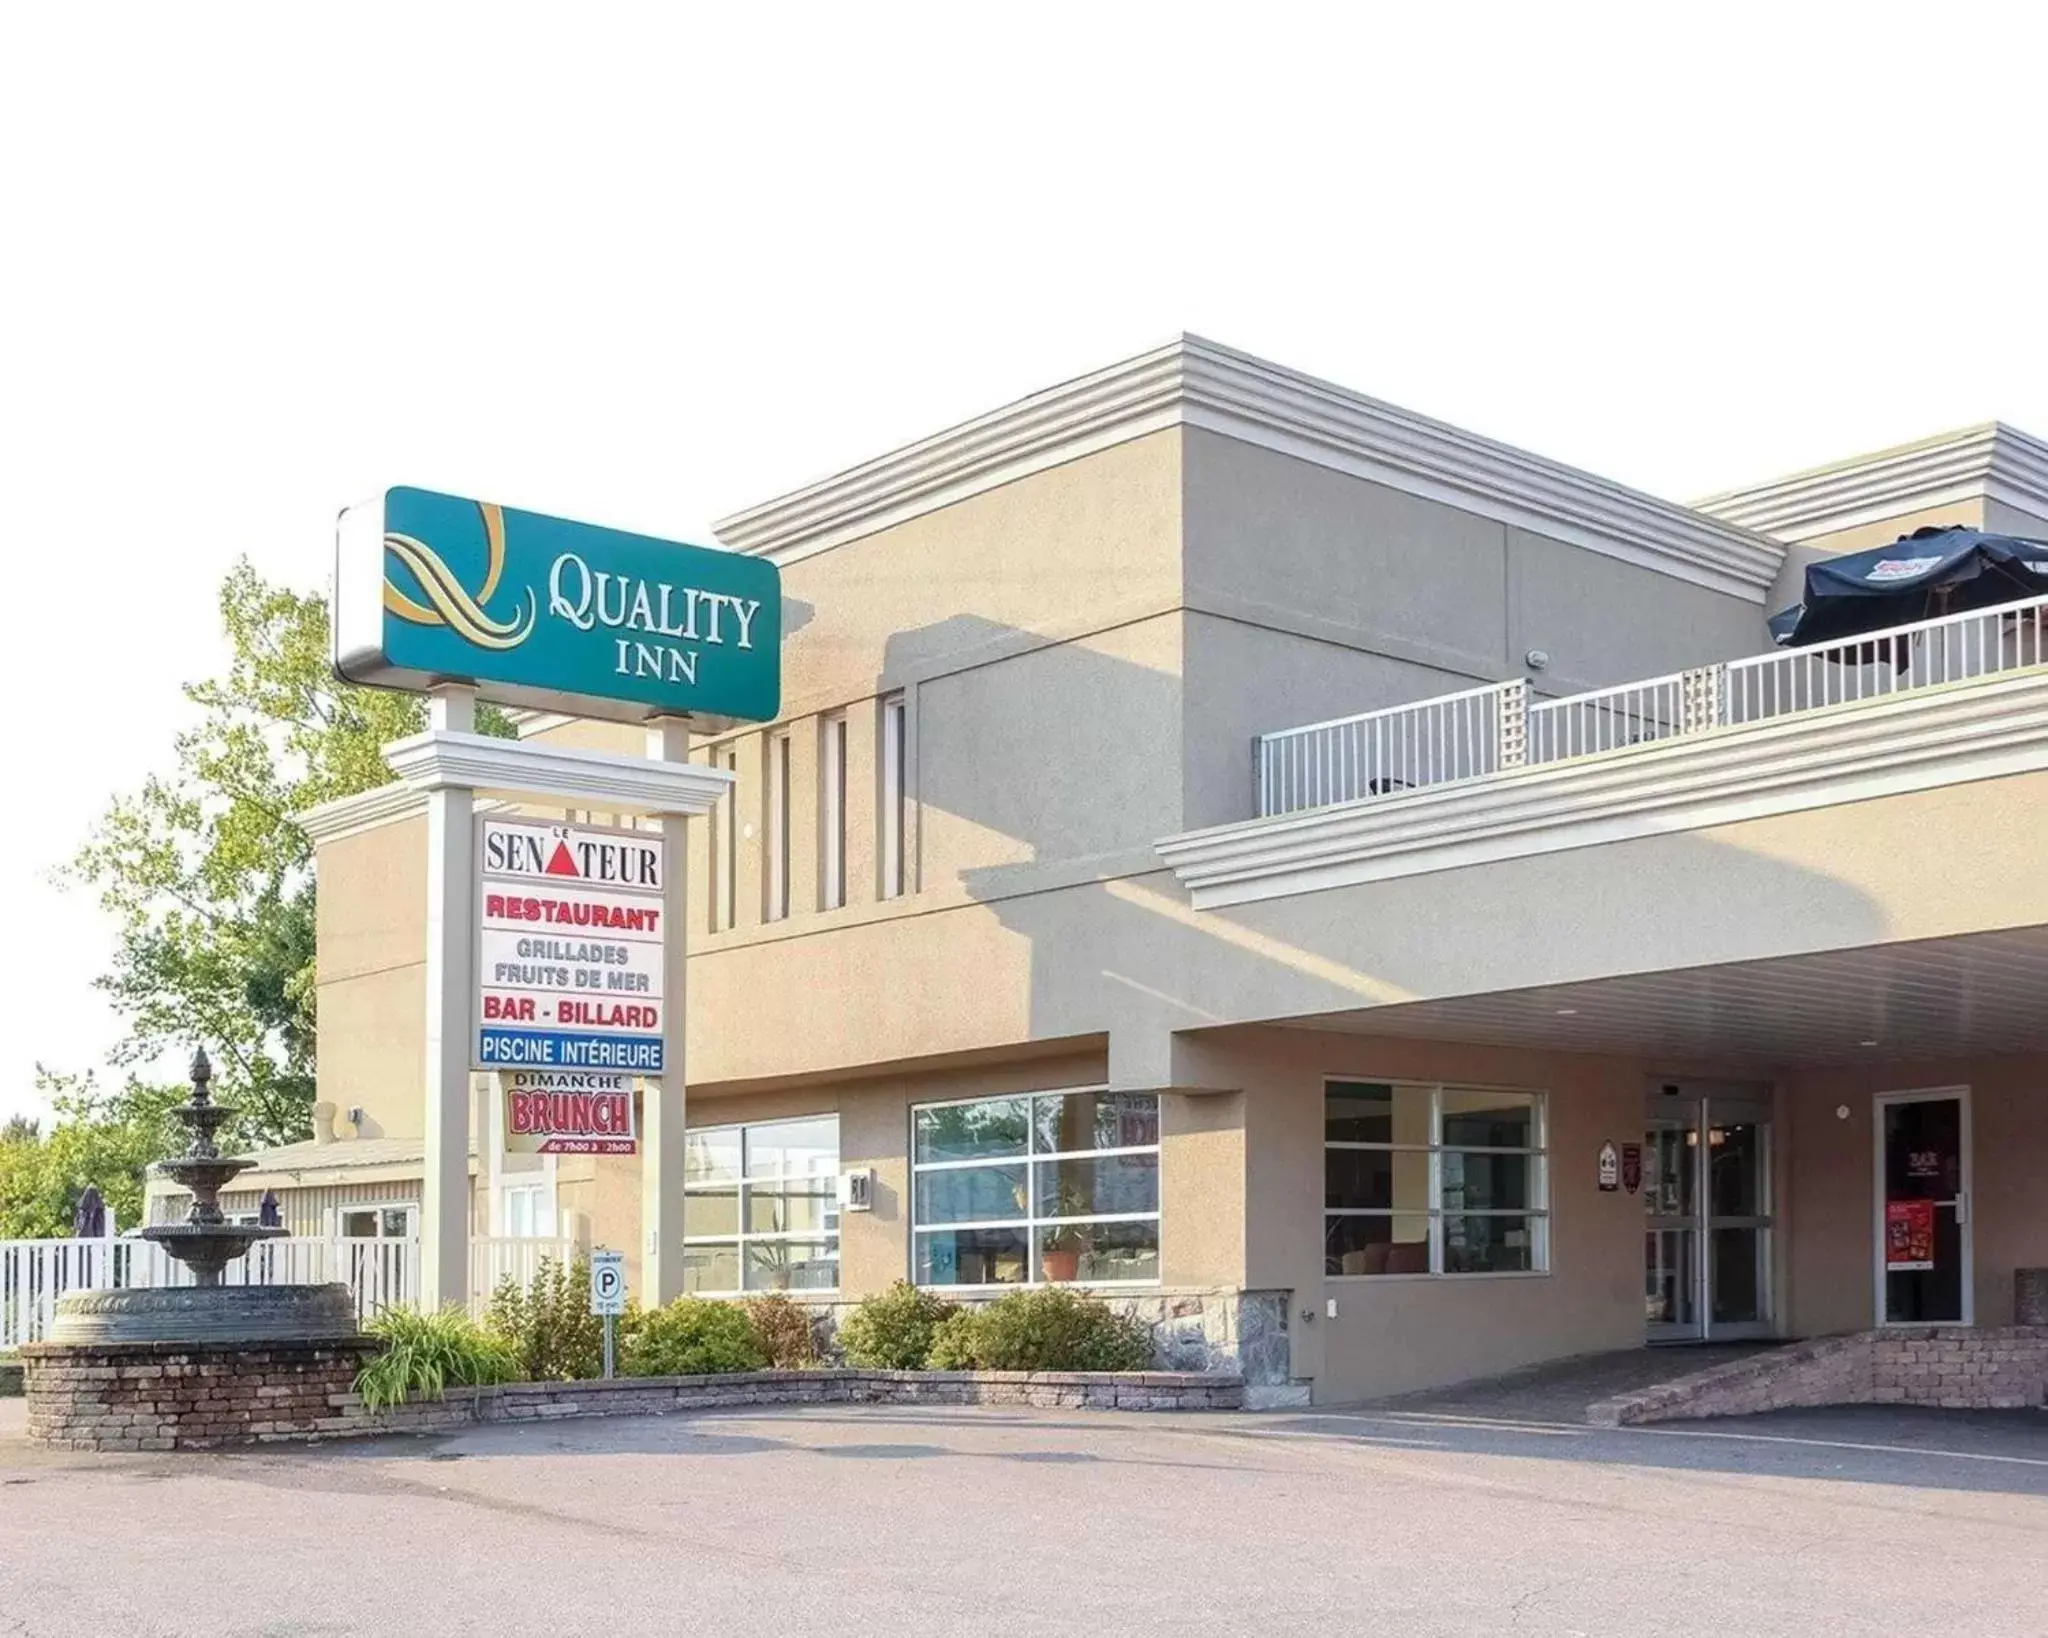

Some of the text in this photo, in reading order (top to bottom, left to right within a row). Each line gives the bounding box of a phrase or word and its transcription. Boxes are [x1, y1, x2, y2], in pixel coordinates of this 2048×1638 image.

[549, 552, 760, 650] QUALITY
[615, 639, 699, 686] INN
[553, 827, 569, 839] LE
[486, 894, 660, 932] RESTAURANT
[516, 937, 629, 966] GRILLADES
[494, 962, 650, 992] FRUITS DE MER
[484, 996, 536, 1021] BAR
[557, 1000, 658, 1028] BILLARD
[482, 1037, 661, 1068] PISCINE INTÉRIEURE
[514, 1072, 623, 1090] DIMANCHE
[508, 1089, 631, 1137] BRUNCH
[602, 1273, 616, 1293] P
